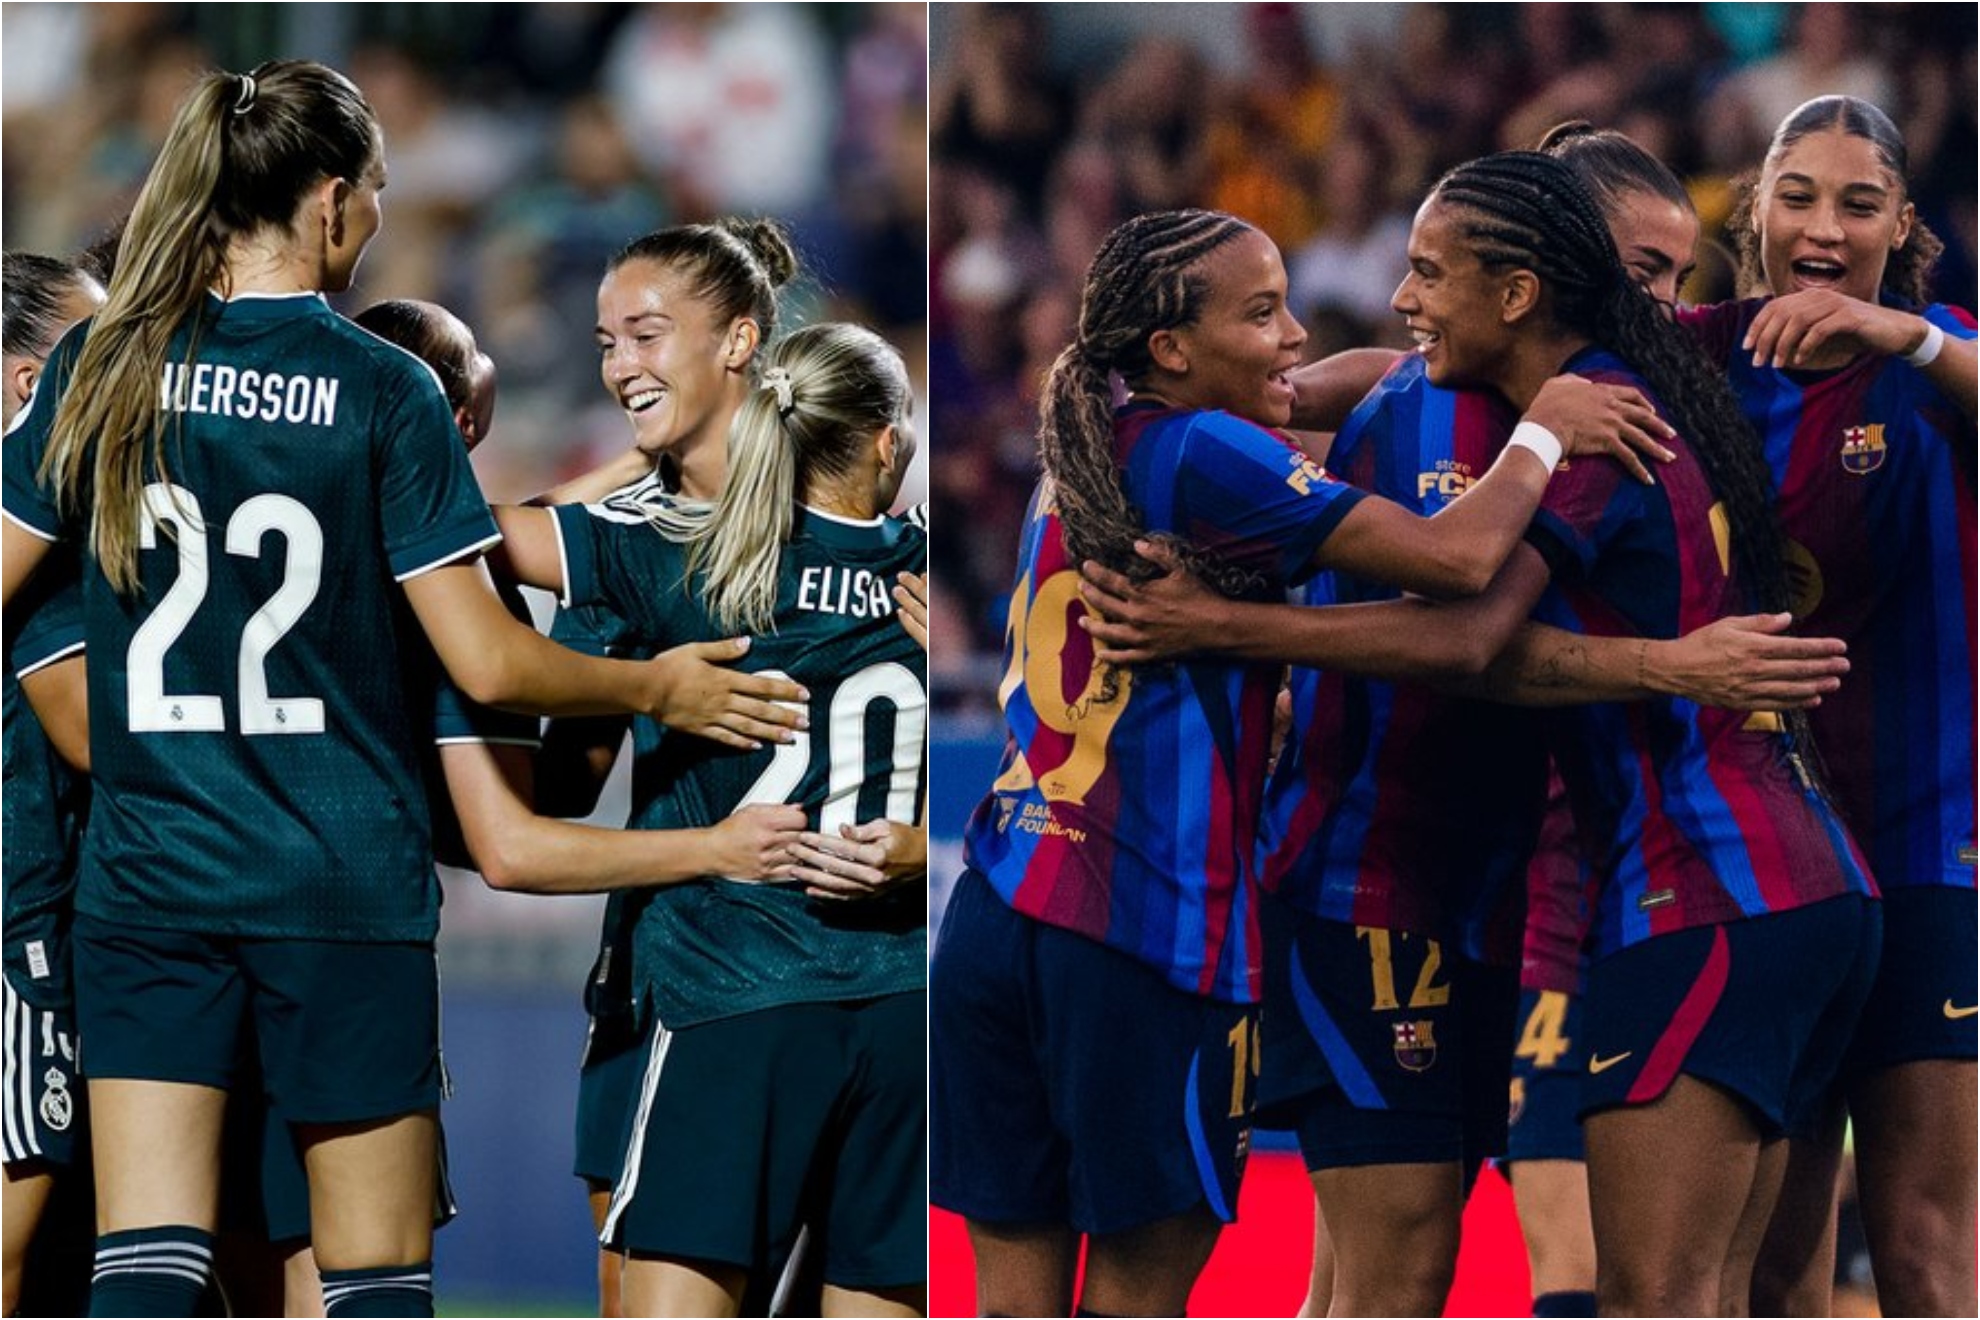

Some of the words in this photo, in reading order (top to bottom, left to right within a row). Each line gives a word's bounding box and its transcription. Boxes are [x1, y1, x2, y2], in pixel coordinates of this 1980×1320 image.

[126, 482, 326, 735] 22
[797, 565, 892, 618] ELISA
[992, 567, 1133, 805] 19
[1356, 925, 1450, 1011] 12
